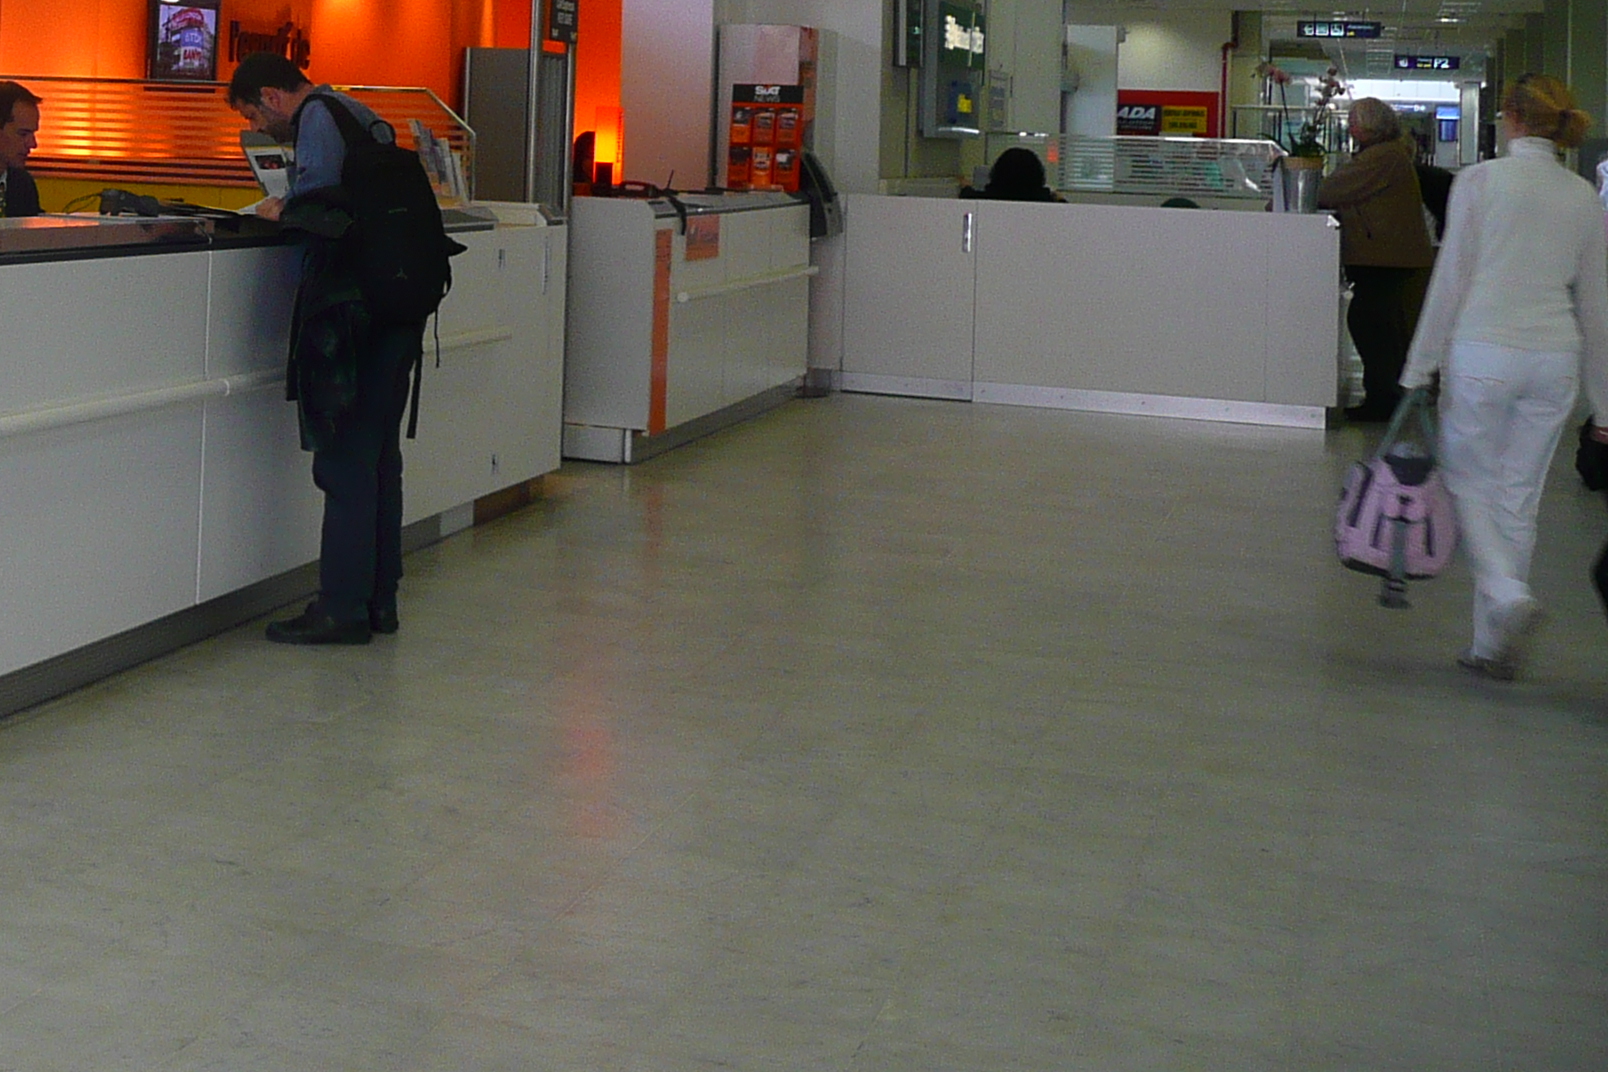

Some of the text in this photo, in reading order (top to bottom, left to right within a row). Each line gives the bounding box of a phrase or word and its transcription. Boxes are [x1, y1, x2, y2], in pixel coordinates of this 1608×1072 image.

[1433, 58, 1450, 69] P2
[754, 94, 780, 103] NEWS
[1117, 106, 1156, 120] ADA
